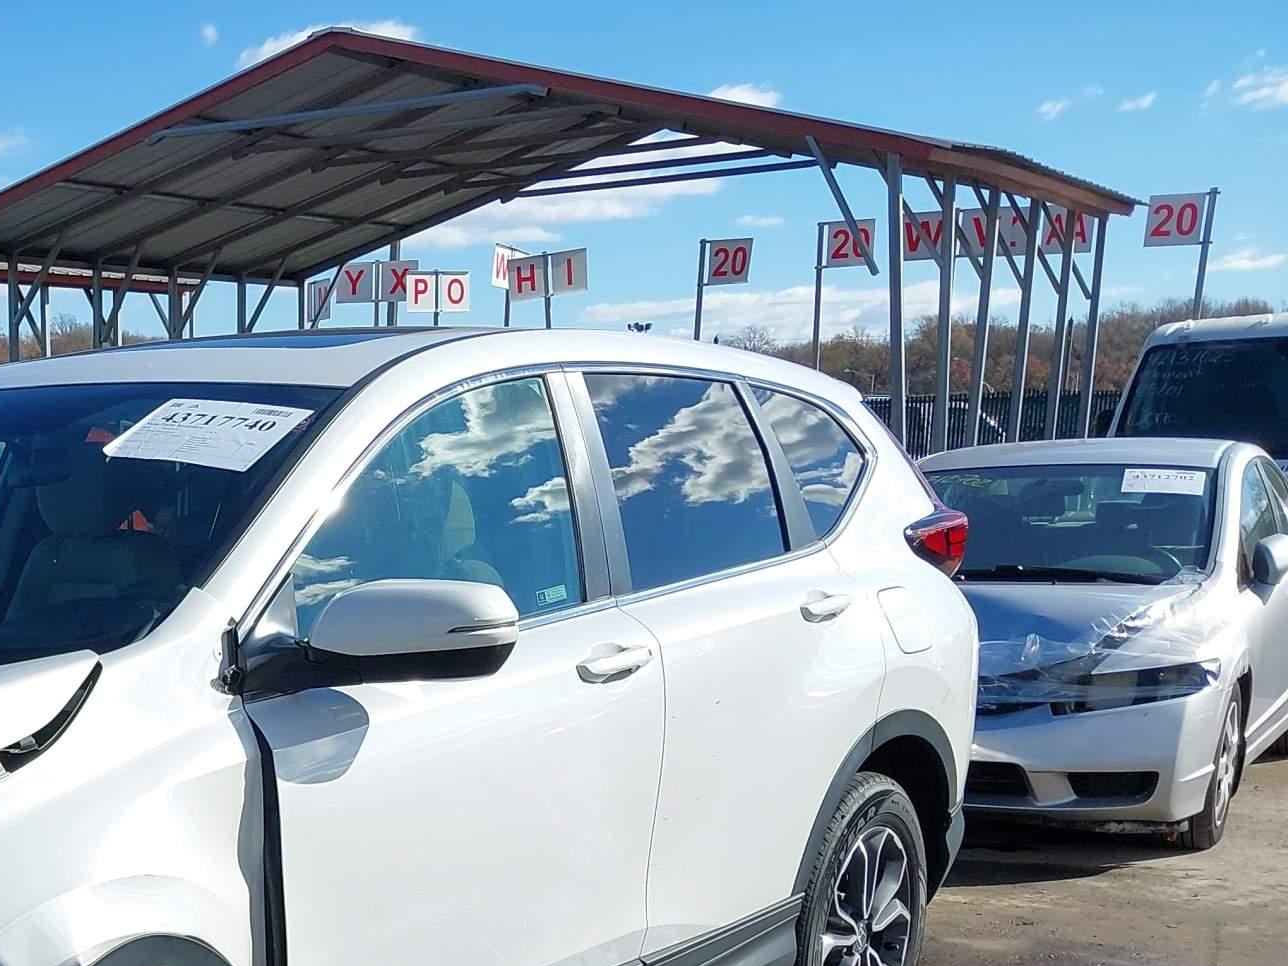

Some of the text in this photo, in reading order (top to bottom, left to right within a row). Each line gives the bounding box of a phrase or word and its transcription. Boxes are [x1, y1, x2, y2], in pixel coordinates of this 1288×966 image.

[1150, 202, 1198, 237] 20
[830, 227, 870, 260] 20
[566, 257, 573, 286] I
[711, 246, 748, 277] 20
[344, 269, 365, 296] Y
[389, 268, 409, 295] X
[414, 278, 429, 305] P
[447, 278, 465, 305] O
[516, 263, 536, 294] H
[161, 410, 278, 432] 43717740
